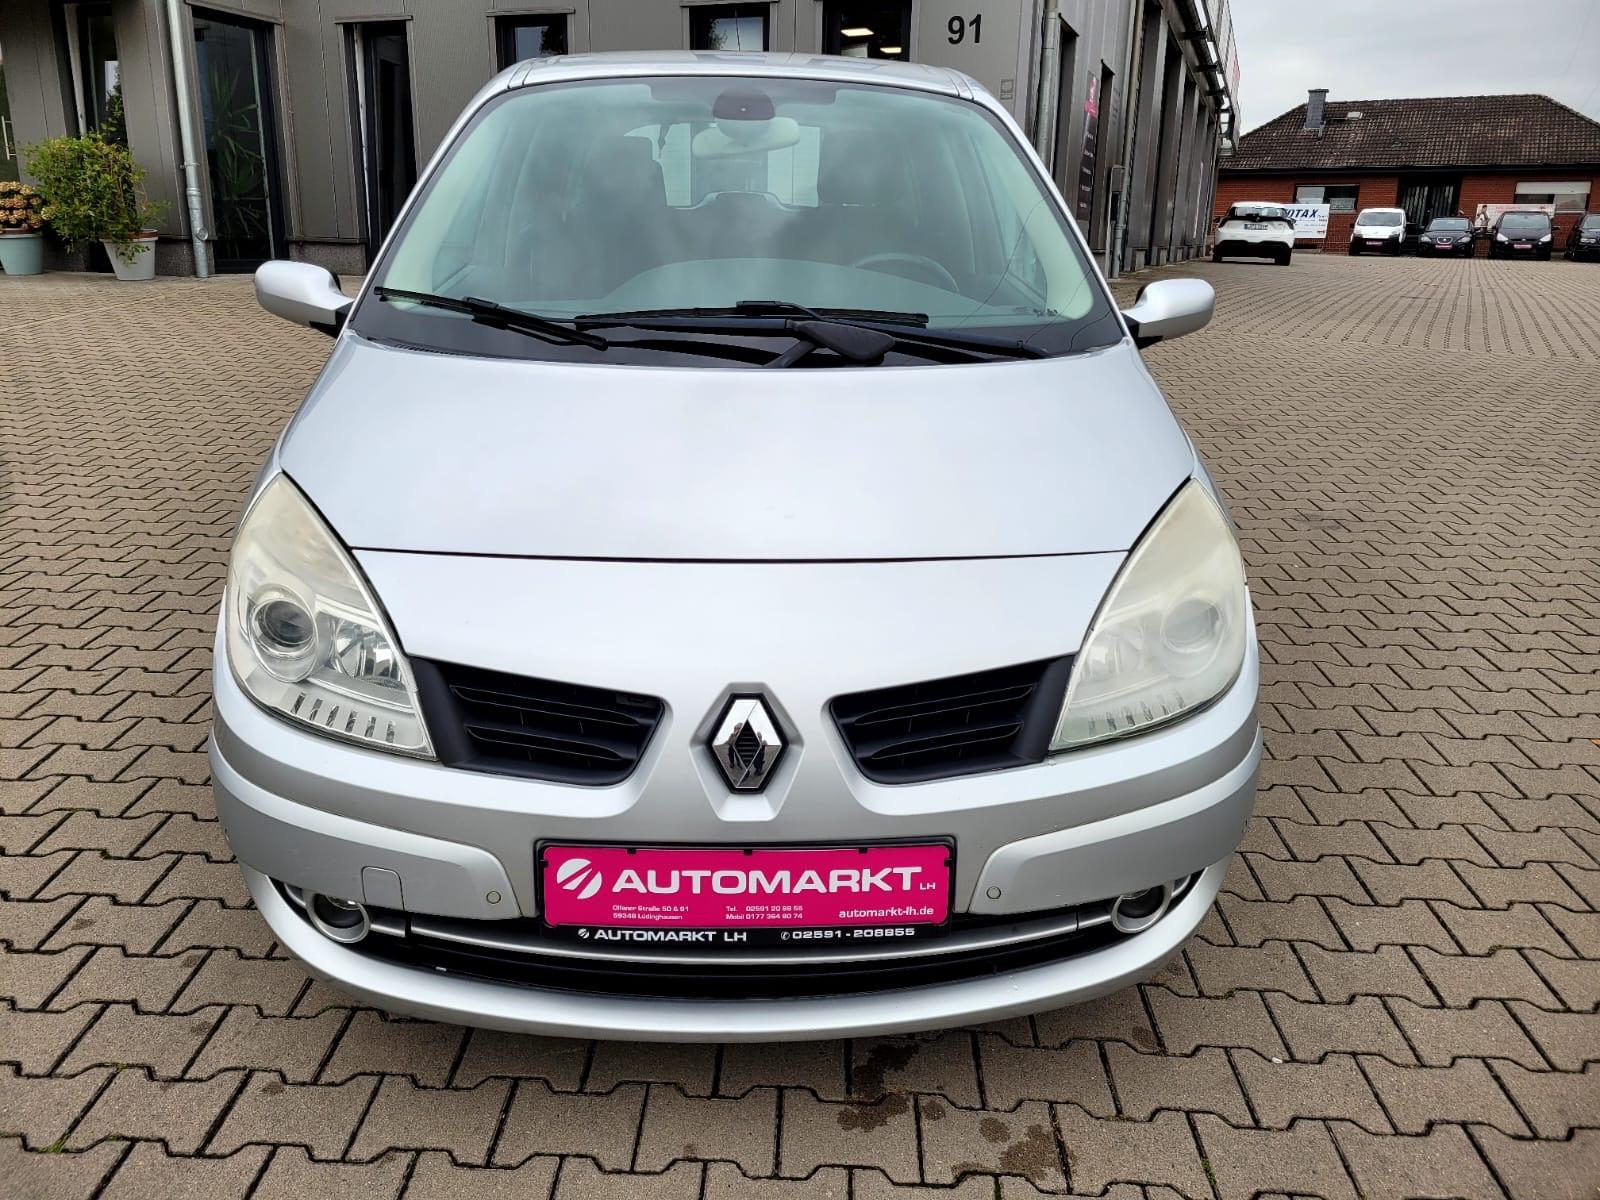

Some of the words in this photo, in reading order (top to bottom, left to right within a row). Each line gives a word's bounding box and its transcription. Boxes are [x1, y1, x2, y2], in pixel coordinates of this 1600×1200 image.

[948, 14, 981, 44] 91
[1285, 208, 1319, 219] OTAX
[612, 867, 922, 894] AUTOMARKT
[919, 882, 936, 891] LH
[838, 906, 934, 919] automarkt-lh.de
[594, 929, 717, 942] AUTOMARKT
[723, 931, 747, 942] LH
[792, 930, 842, 940] 02591
[853, 927, 915, 938] 208855
